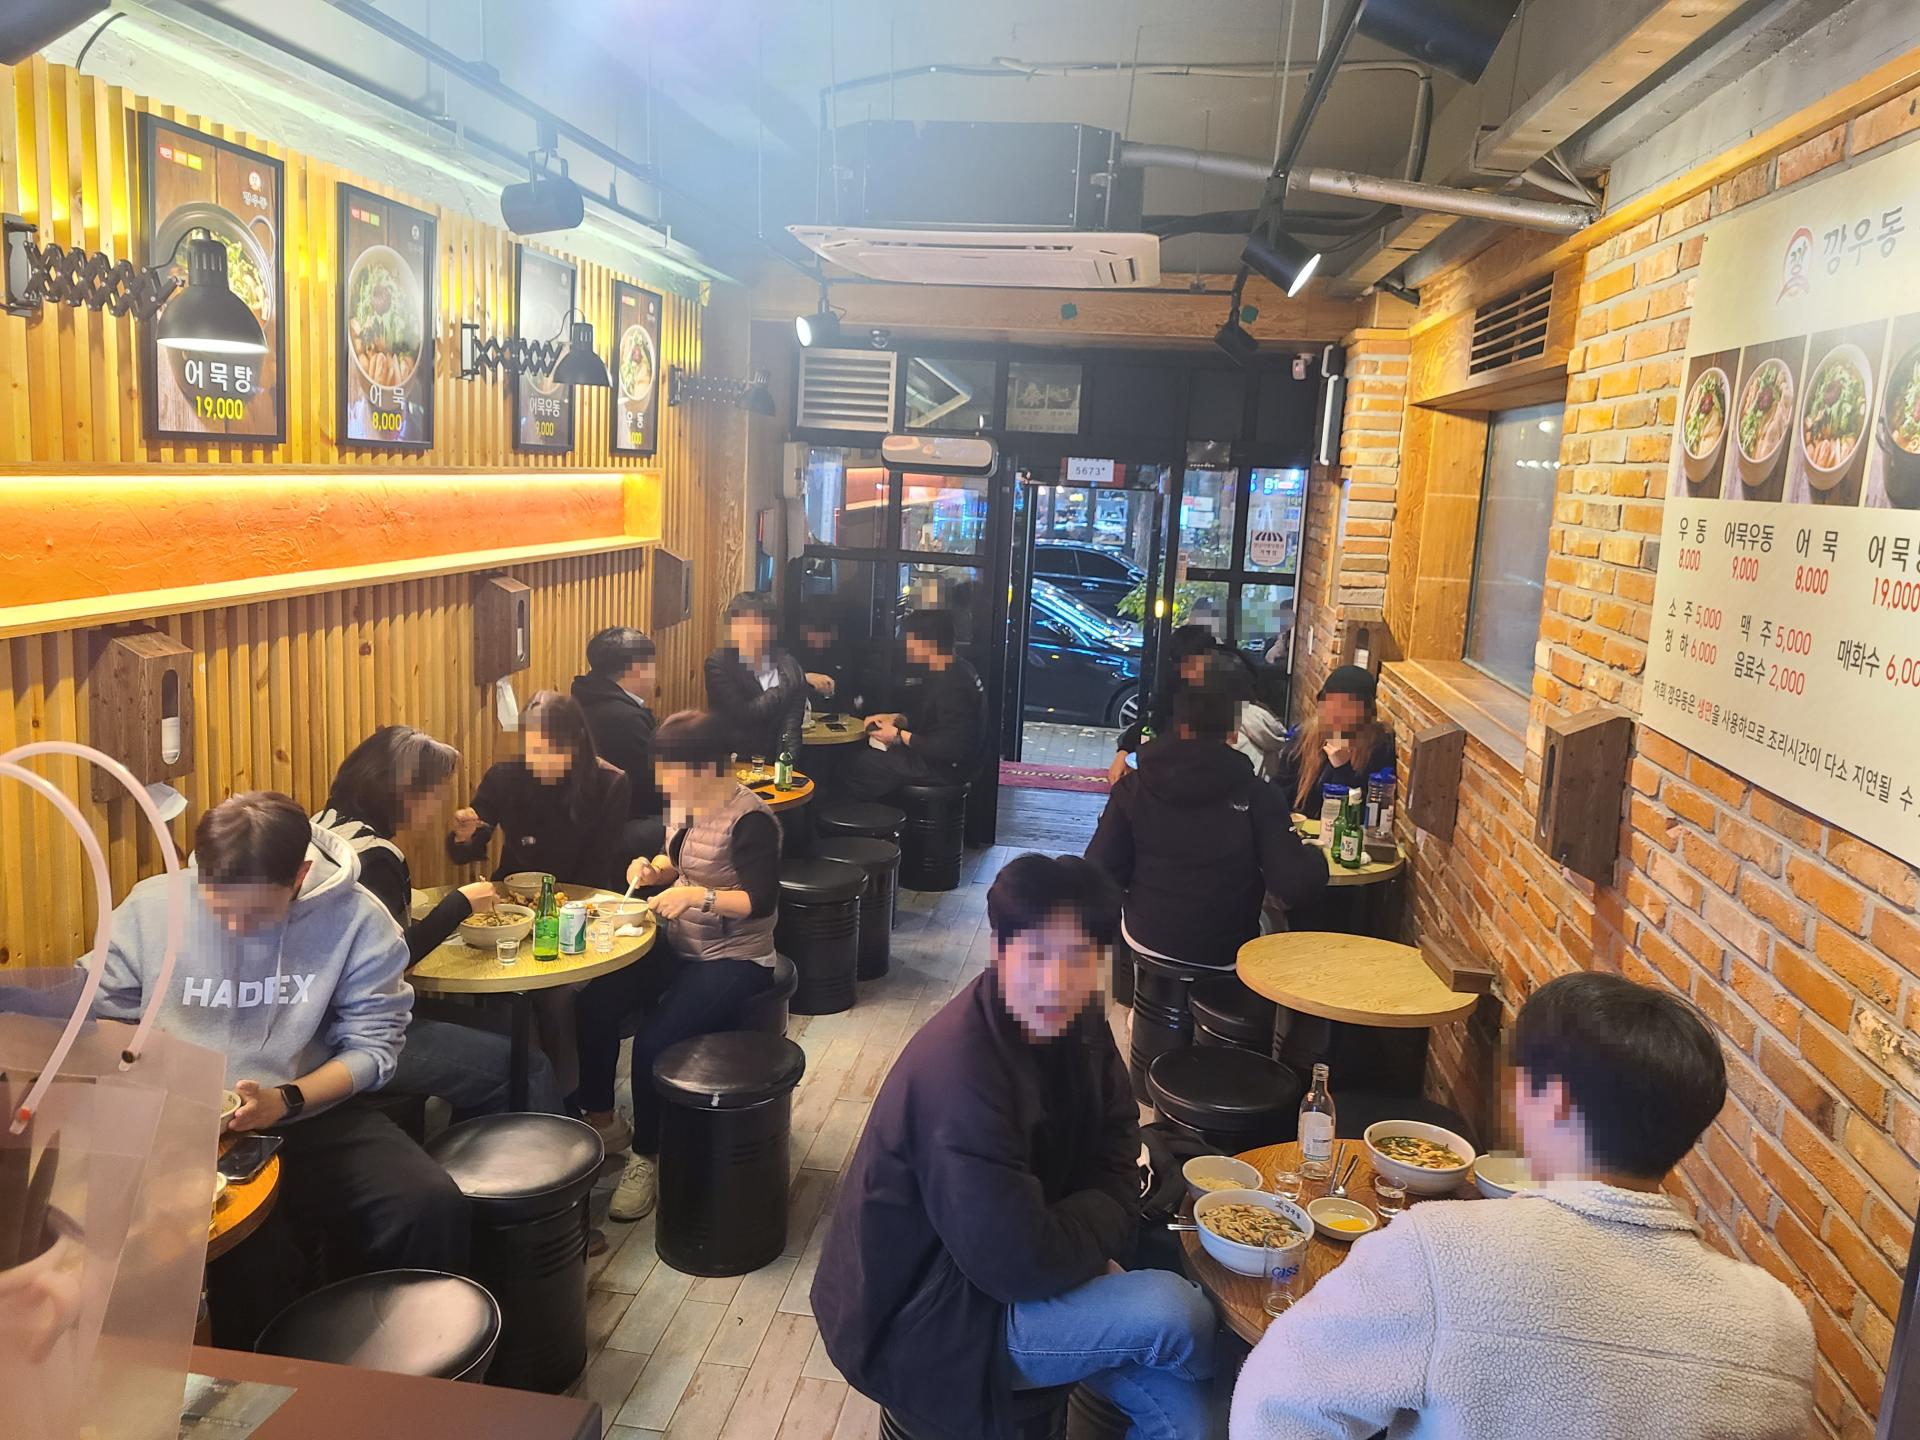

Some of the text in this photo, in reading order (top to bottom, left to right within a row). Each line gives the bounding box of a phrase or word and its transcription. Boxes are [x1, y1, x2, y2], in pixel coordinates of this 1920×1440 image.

[1823, 206, 1905, 275] 깡우동
[185, 359, 253, 393] 어묵탕
[195, 395, 244, 420] 19,000
[372, 411, 402, 431] 8,000
[529, 396, 560, 418] 어묵우동
[1724, 521, 1775, 553] 어묵우동
[1872, 577, 1920, 613] 19,000
[1695, 605, 1722, 631] 5,000
[1775, 625, 1812, 656] 5,000
[1837, 639, 1880, 678] 매화수
[1690, 638, 1717, 665] 6,000
[1734, 651, 1766, 685] 음료수
[1768, 664, 1806, 696] 2,000
[1722, 709, 1765, 745] 사용하므로
[1766, 729, 1822, 772] 조리시간이
[1824, 753, 1848, 782] 다소
[1852, 764, 1892, 804] 지연될
[1899, 785, 1913, 812] 수
[182, 973, 317, 1009] HADEX
